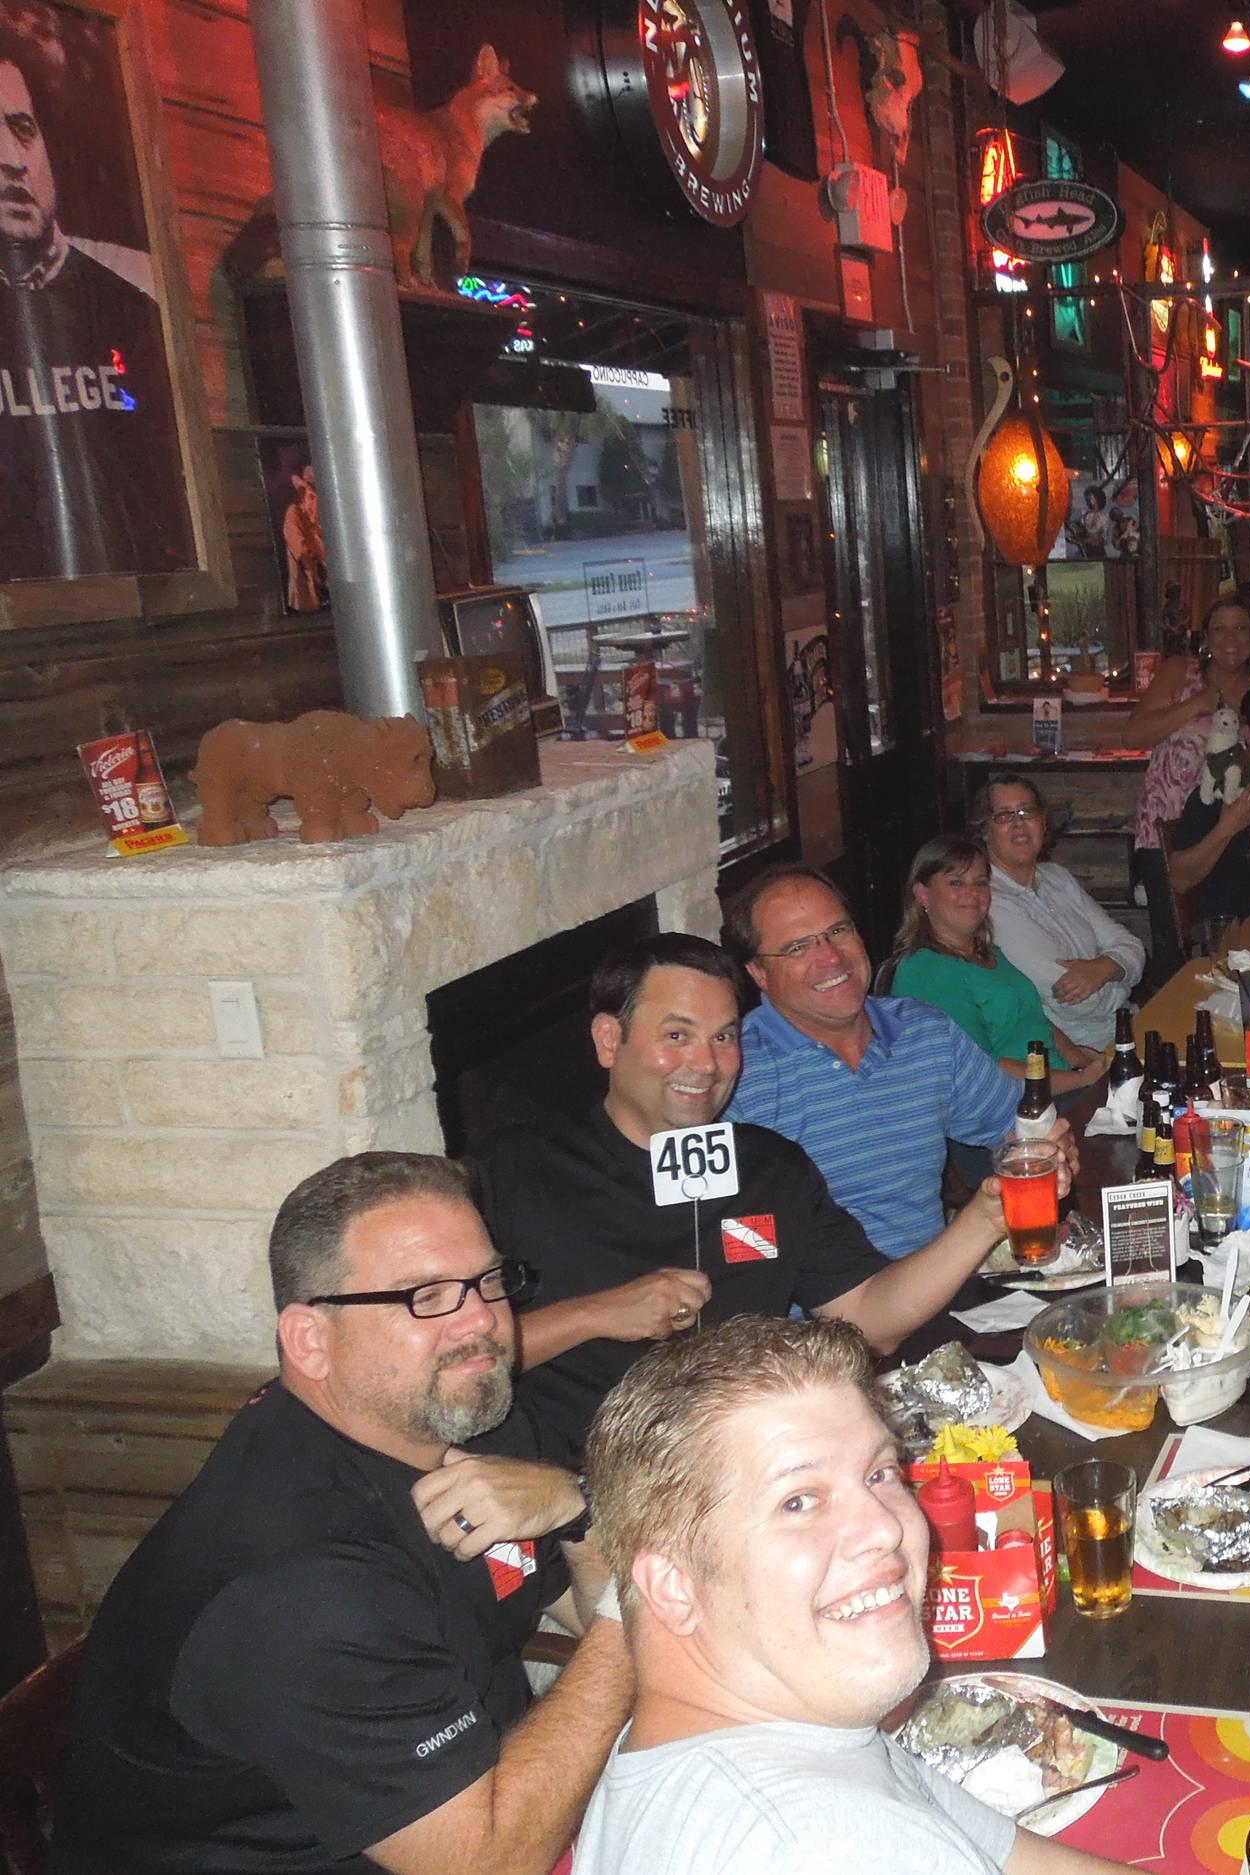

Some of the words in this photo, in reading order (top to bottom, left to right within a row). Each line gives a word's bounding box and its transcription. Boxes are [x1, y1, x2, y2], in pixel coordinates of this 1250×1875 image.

[674, 152, 752, 215] BREWING
[1058, 185, 1096, 205] Head
[0, 364, 125, 417] LLEGE
[100, 796, 140, 823] $18
[656, 1128, 731, 1181] 465
[988, 1476, 1011, 1485] LONE
[988, 1483, 1012, 1493] STAR
[415, 1710, 478, 1758] GWNDWN
